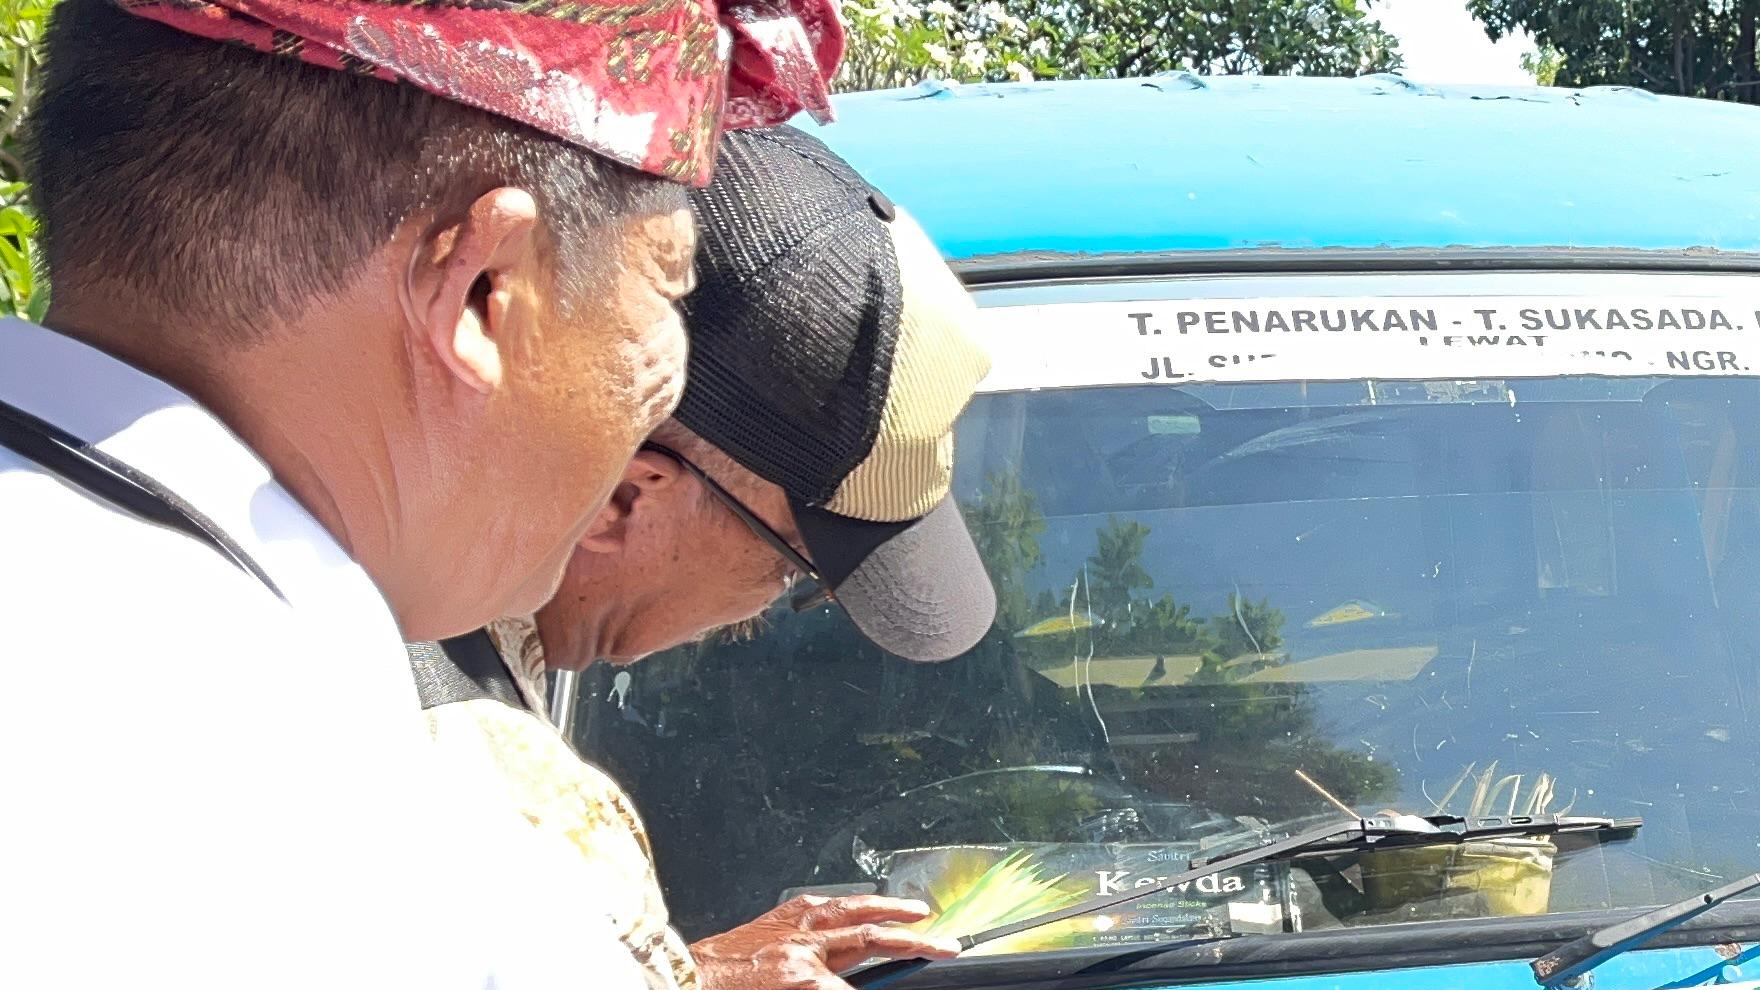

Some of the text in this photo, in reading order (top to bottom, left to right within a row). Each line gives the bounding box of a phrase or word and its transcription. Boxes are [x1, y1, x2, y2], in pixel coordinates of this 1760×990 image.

[1128, 312, 1162, 335] T.
[1176, 310, 1438, 333] PENARUKAN
[1473, 310, 1507, 331] T.
[1666, 351, 1750, 371] NGR.
